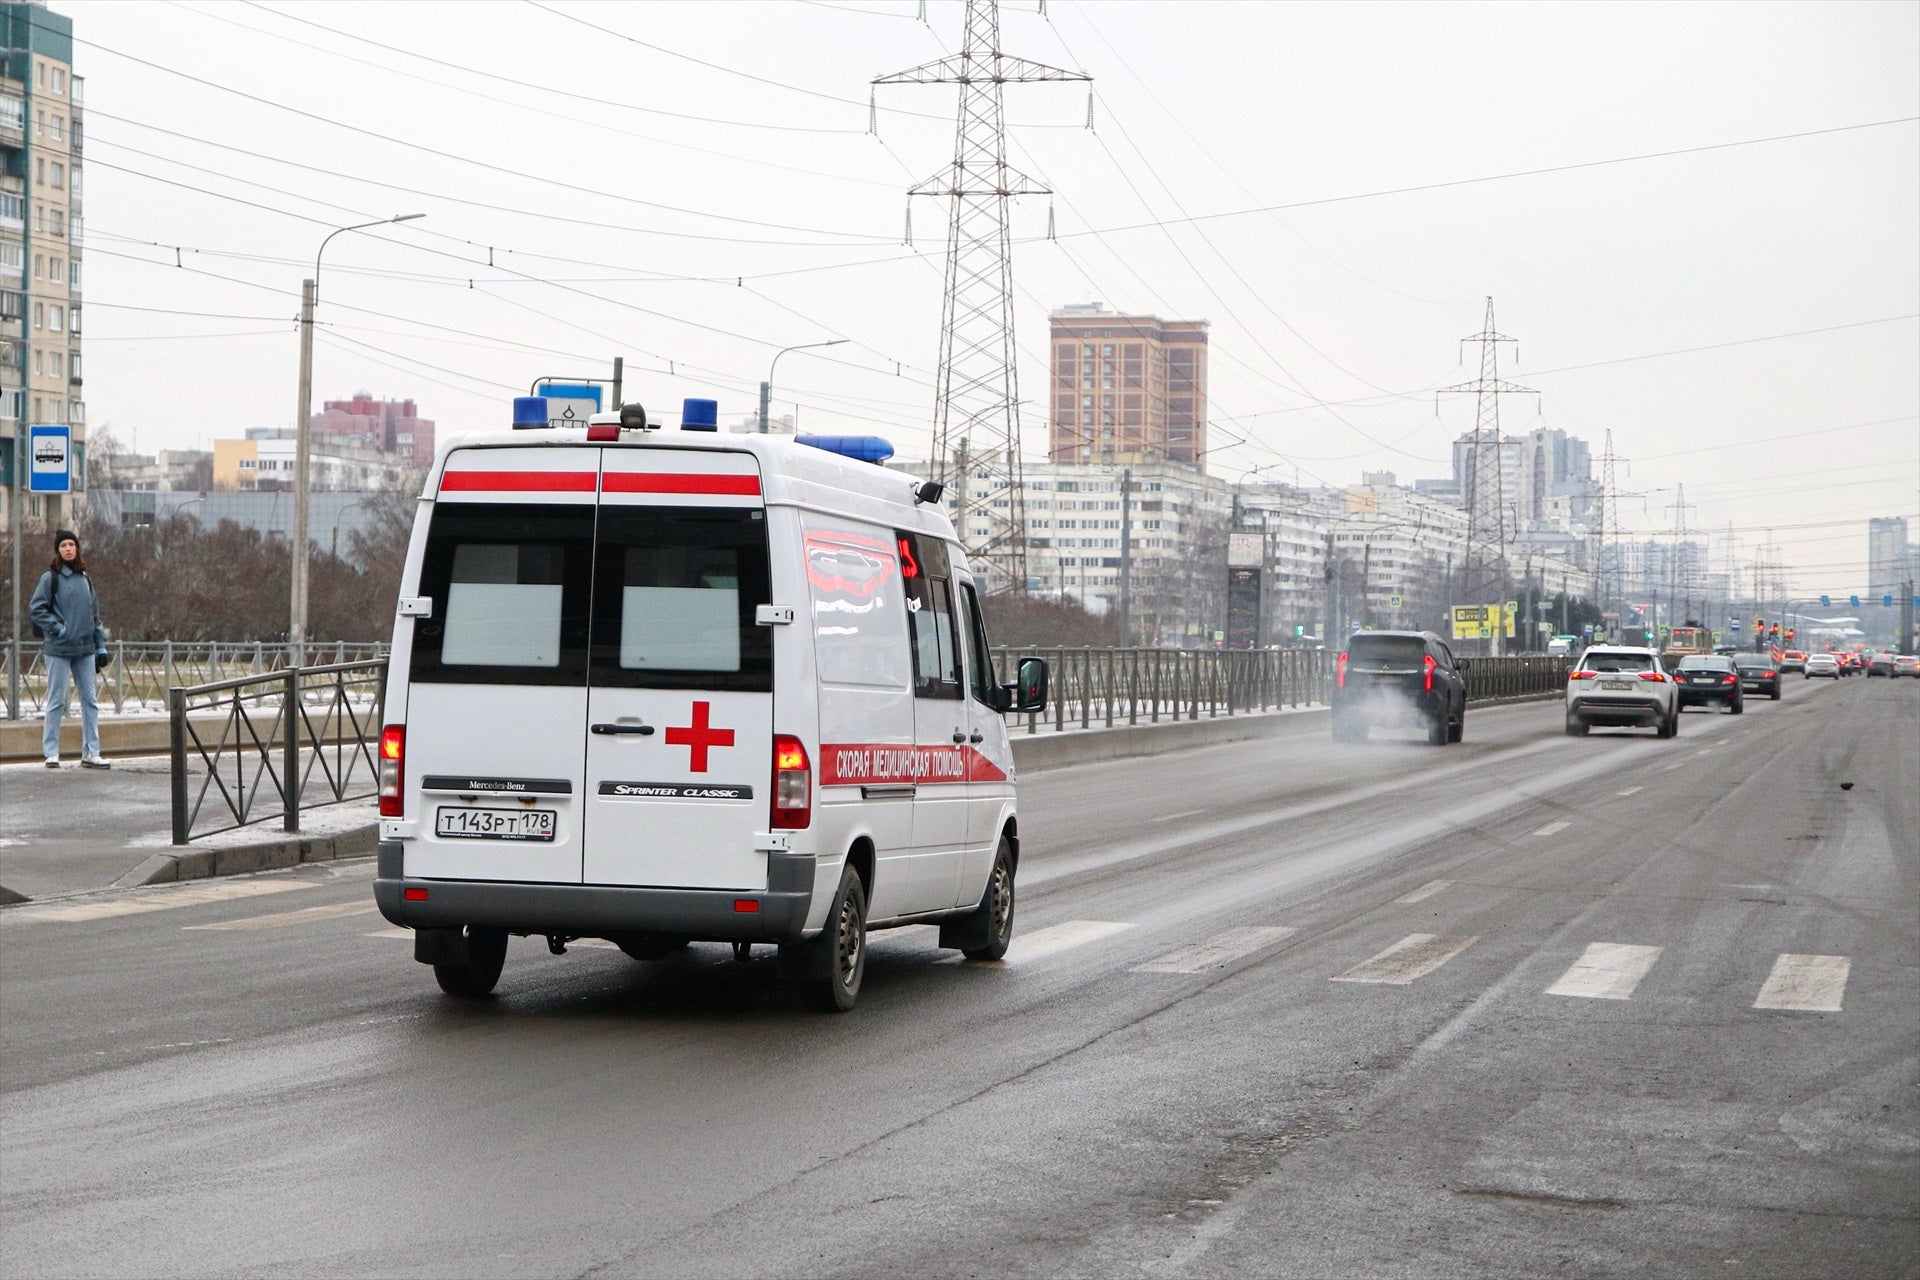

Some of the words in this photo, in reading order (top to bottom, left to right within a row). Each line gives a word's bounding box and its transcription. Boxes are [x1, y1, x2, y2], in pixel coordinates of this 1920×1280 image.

[836, 750, 870, 778] СКОРАЯ
[872, 750, 930, 779] МЕДИЦИНСКАЯ
[933, 751, 964, 778] ПОМОЩЬ
[469, 780, 526, 791] Mercedes-Benz
[614, 784, 678, 796] SPRINTER
[683, 788, 740, 798] CLASSIC
[522, 813, 550, 828] 178
